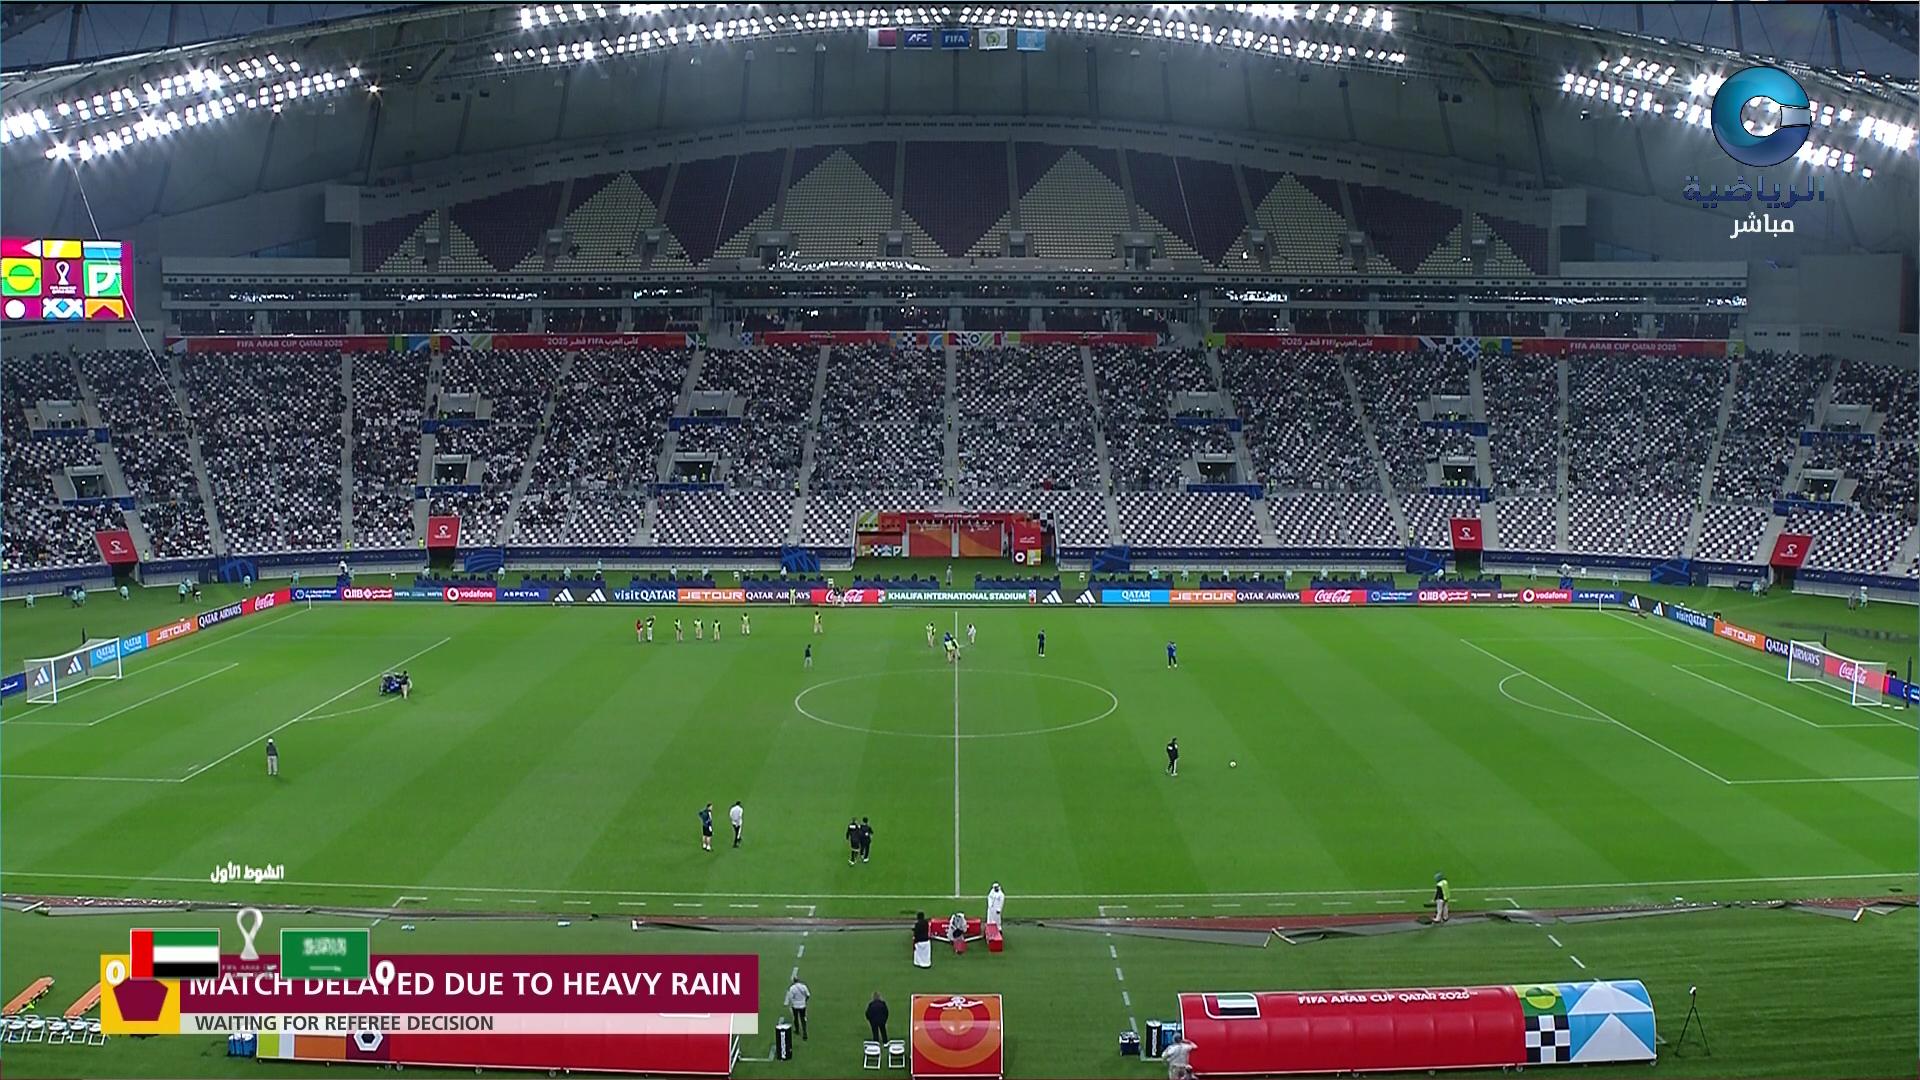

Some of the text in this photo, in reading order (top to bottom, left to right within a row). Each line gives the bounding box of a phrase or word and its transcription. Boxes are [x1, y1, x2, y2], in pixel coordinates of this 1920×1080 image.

[908, 33, 928, 43] AFC
[945, 35, 965, 44] FIFA
[236, 340, 254, 348] FIFA
[256, 340, 279, 348] ARAB
[281, 340, 297, 348] CUP
[298, 340, 322, 349] QATAR
[1570, 342, 1587, 350] FIFA
[460, 590, 493, 598] vodafone
[681, 591, 743, 600] JETOUR
[746, 591, 811, 600] QATAR AIRAYS
[826, 589, 864, 603] Co-Cola
[888, 592, 1026, 601] KHALIFA INTERNATIONAL STADIUM
[1121, 590, 1151, 600] QATAR
[1171, 592, 1235, 601] JETOUR
[1237, 592, 1300, 601] QATAR AIRWAYS
[1535, 592, 1568, 600] vodafone
[198, 603, 242, 628] QATAR AIRWAYS
[156, 622, 191, 642] JETOUR
[1720, 623, 1757, 645] JETOUR
[123, 635, 142, 650] QATAR
[1765, 638, 1789, 656] QATAR
[1298, 995, 1328, 1005] FIFA
[1331, 994, 1367, 1004] ARAB
[1370, 993, 1395, 1003] CUP
[1398, 991, 1437, 1003] QATAR
